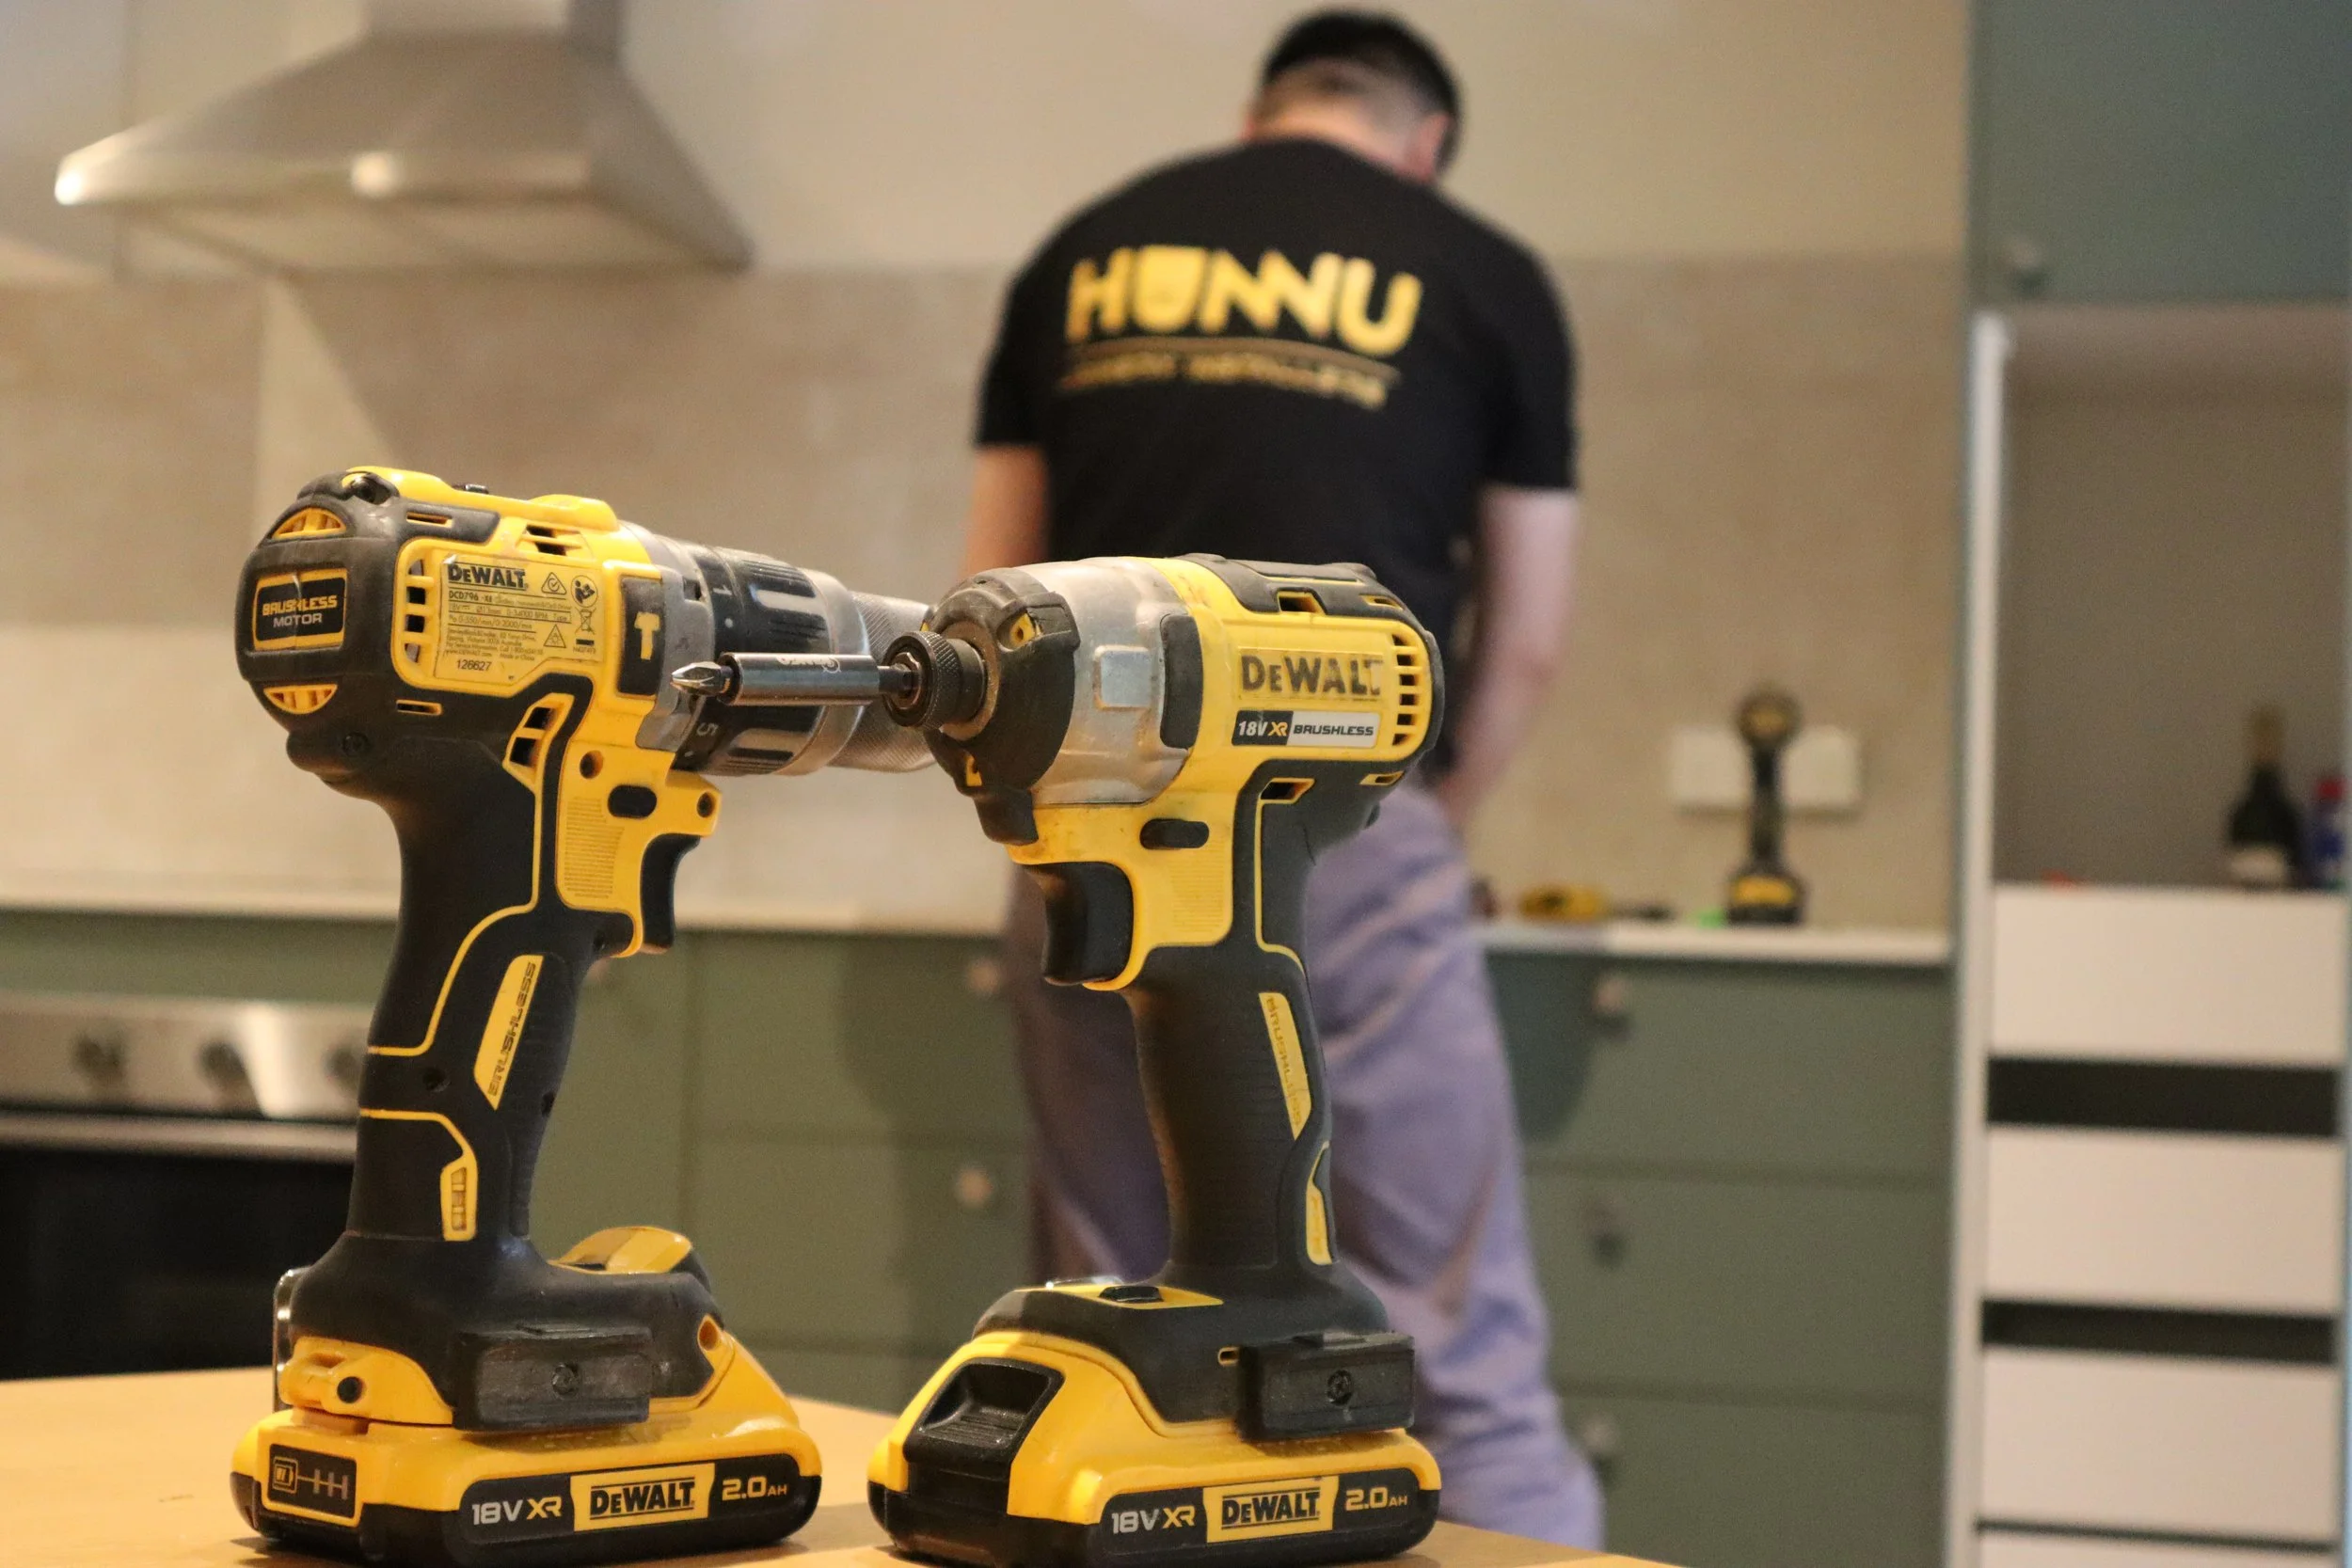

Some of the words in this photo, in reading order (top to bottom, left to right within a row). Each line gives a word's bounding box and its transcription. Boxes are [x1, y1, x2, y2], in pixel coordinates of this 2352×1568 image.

[273, 612, 323, 628] MOTOR
[1238, 721, 1268, 736] 18V
[1267, 721, 1289, 736] XR
[1294, 724, 1375, 736] BRUSHLESS
[487, 961, 536, 1097] BRUSHLESS
[471, 1499, 523, 1526] 18V
[526, 1496, 563, 1520] XR
[1111, 1509, 1159, 1534] 18V
[1162, 1505, 1196, 1529] XR
